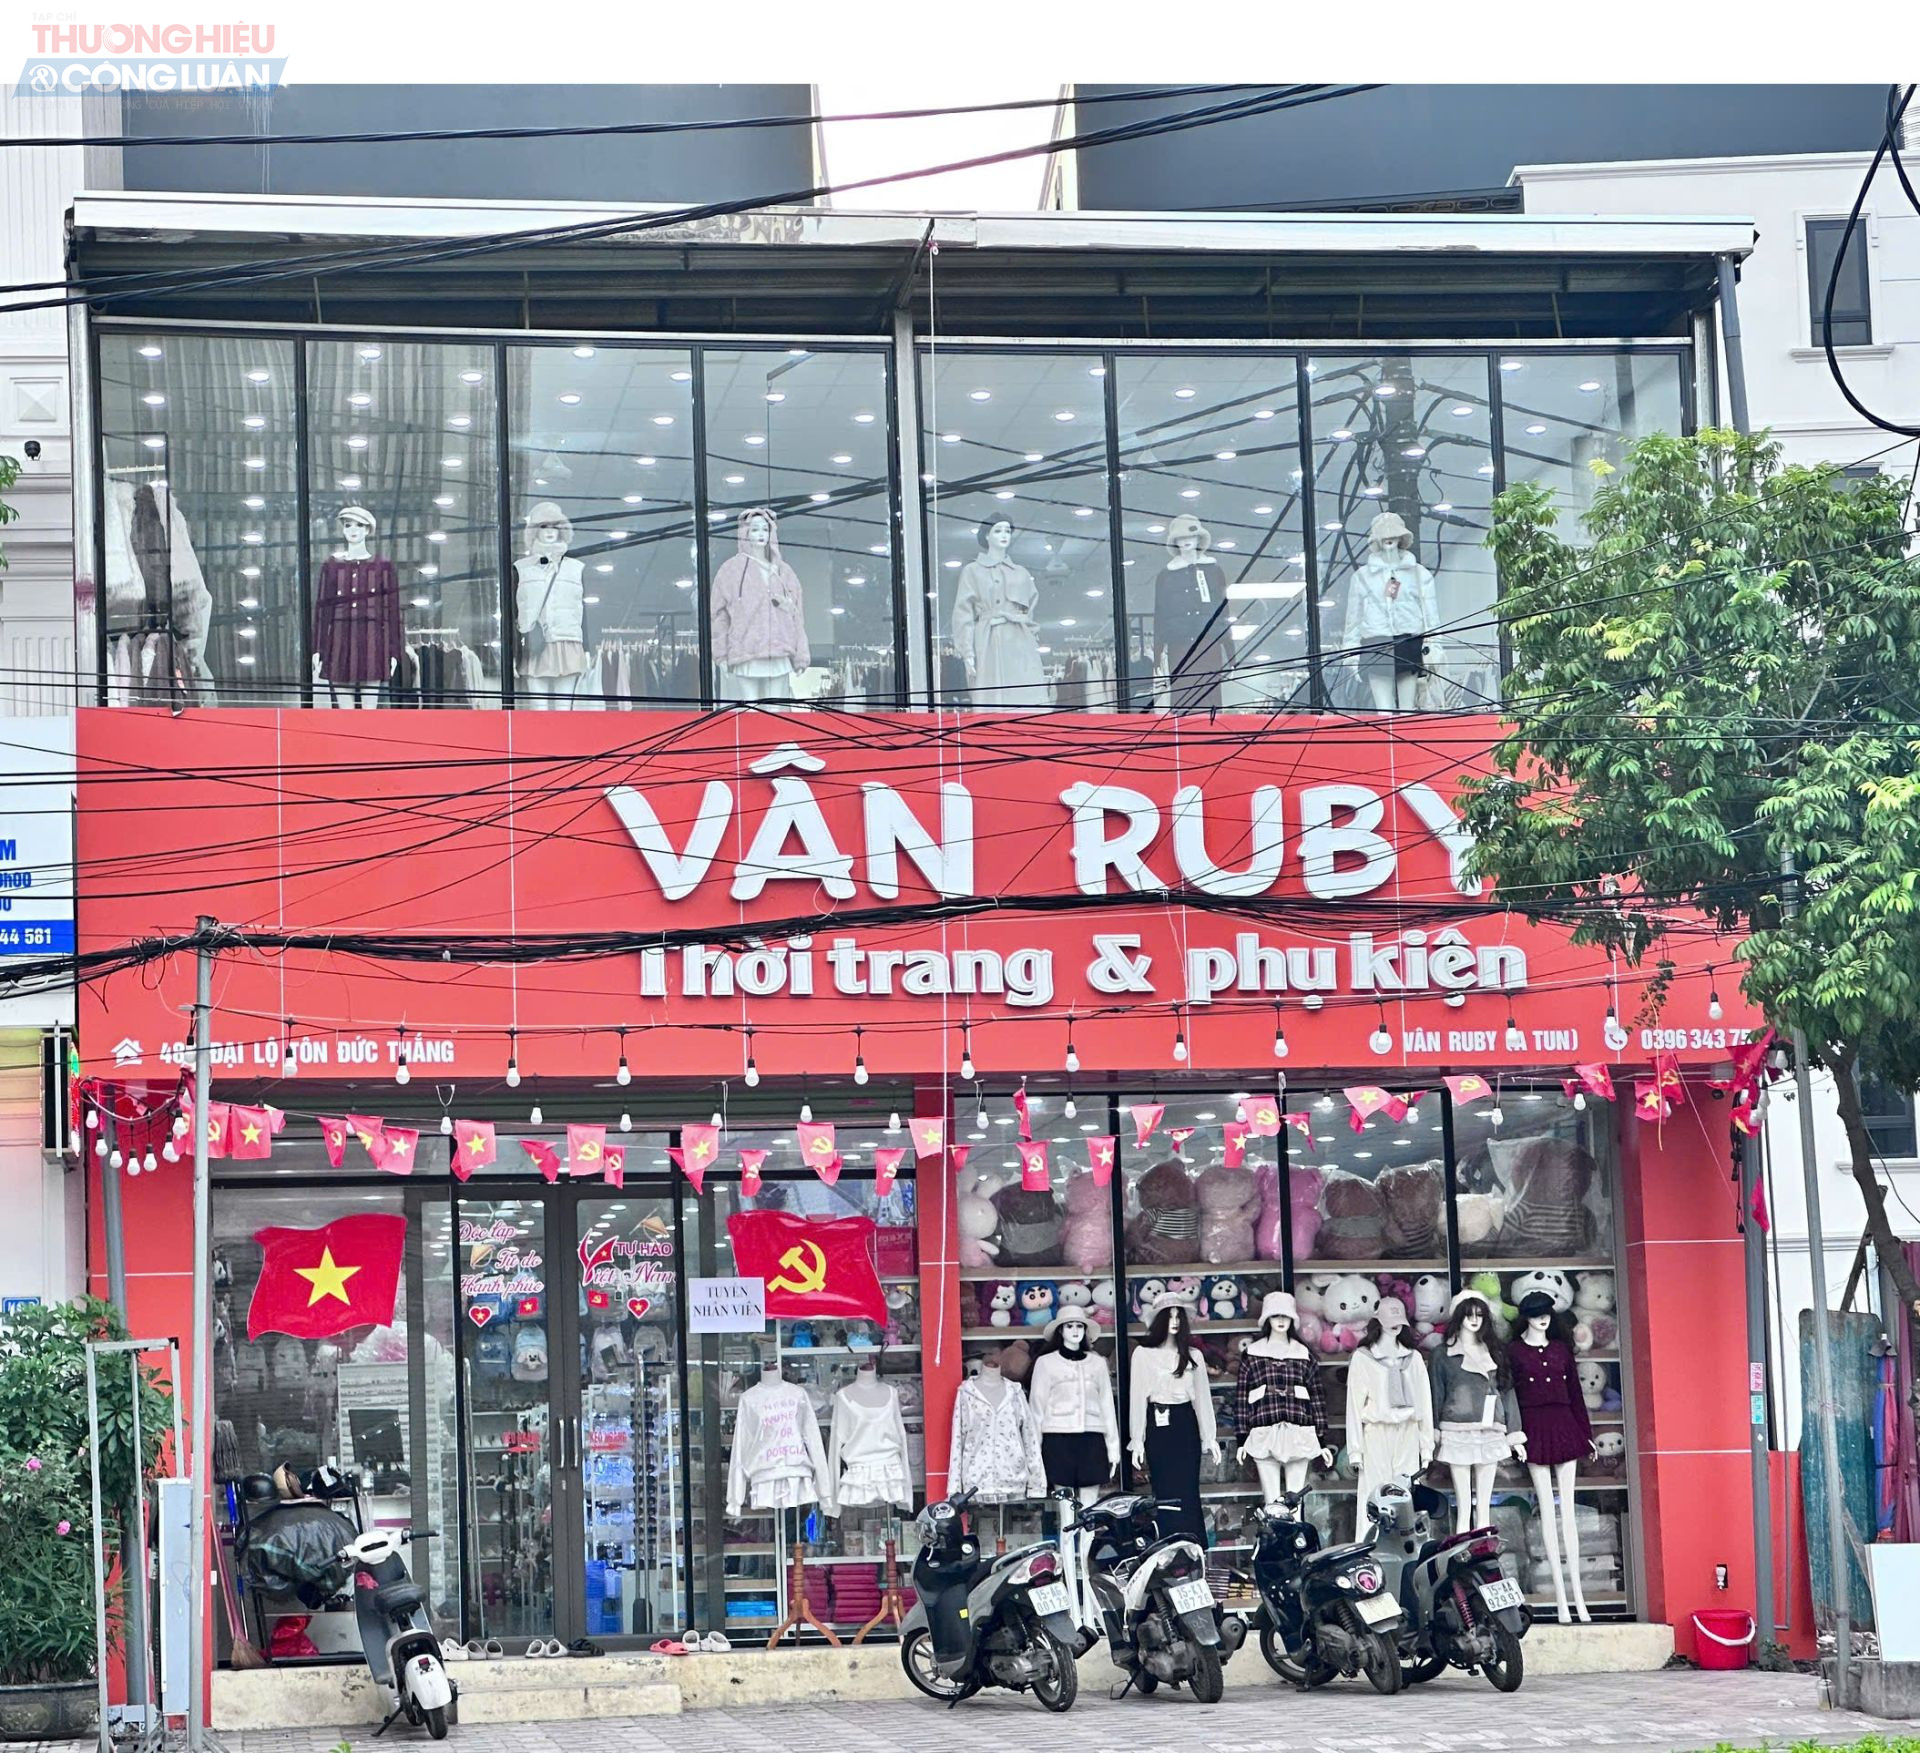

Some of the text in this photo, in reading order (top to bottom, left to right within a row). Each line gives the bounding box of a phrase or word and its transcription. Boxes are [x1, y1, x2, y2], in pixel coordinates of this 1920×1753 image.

[603, 743, 1484, 901] VÂN RUBY
[640, 928, 1528, 1010] Thời trang & phụ kiện
[208, 1041, 245, 1069] ĐẠI
[253, 1036, 279, 1069] LỘ
[290, 1037, 328, 1064] TÔN
[337, 1035, 379, 1064] ĐỨC
[386, 1032, 455, 1064] THẮNG
[1403, 1027, 1441, 1053] VÂN
[1448, 1030, 1498, 1053] RUBY
[1532, 1028, 1579, 1053] TUN)
[1641, 1029, 1687, 1050] 0396
[1690, 1029, 1726, 1049] 343
[520, 1249, 543, 1269] do
[640, 1238, 673, 1257] HÀO
[692, 1301, 763, 1317] NHÂN VIÊN
